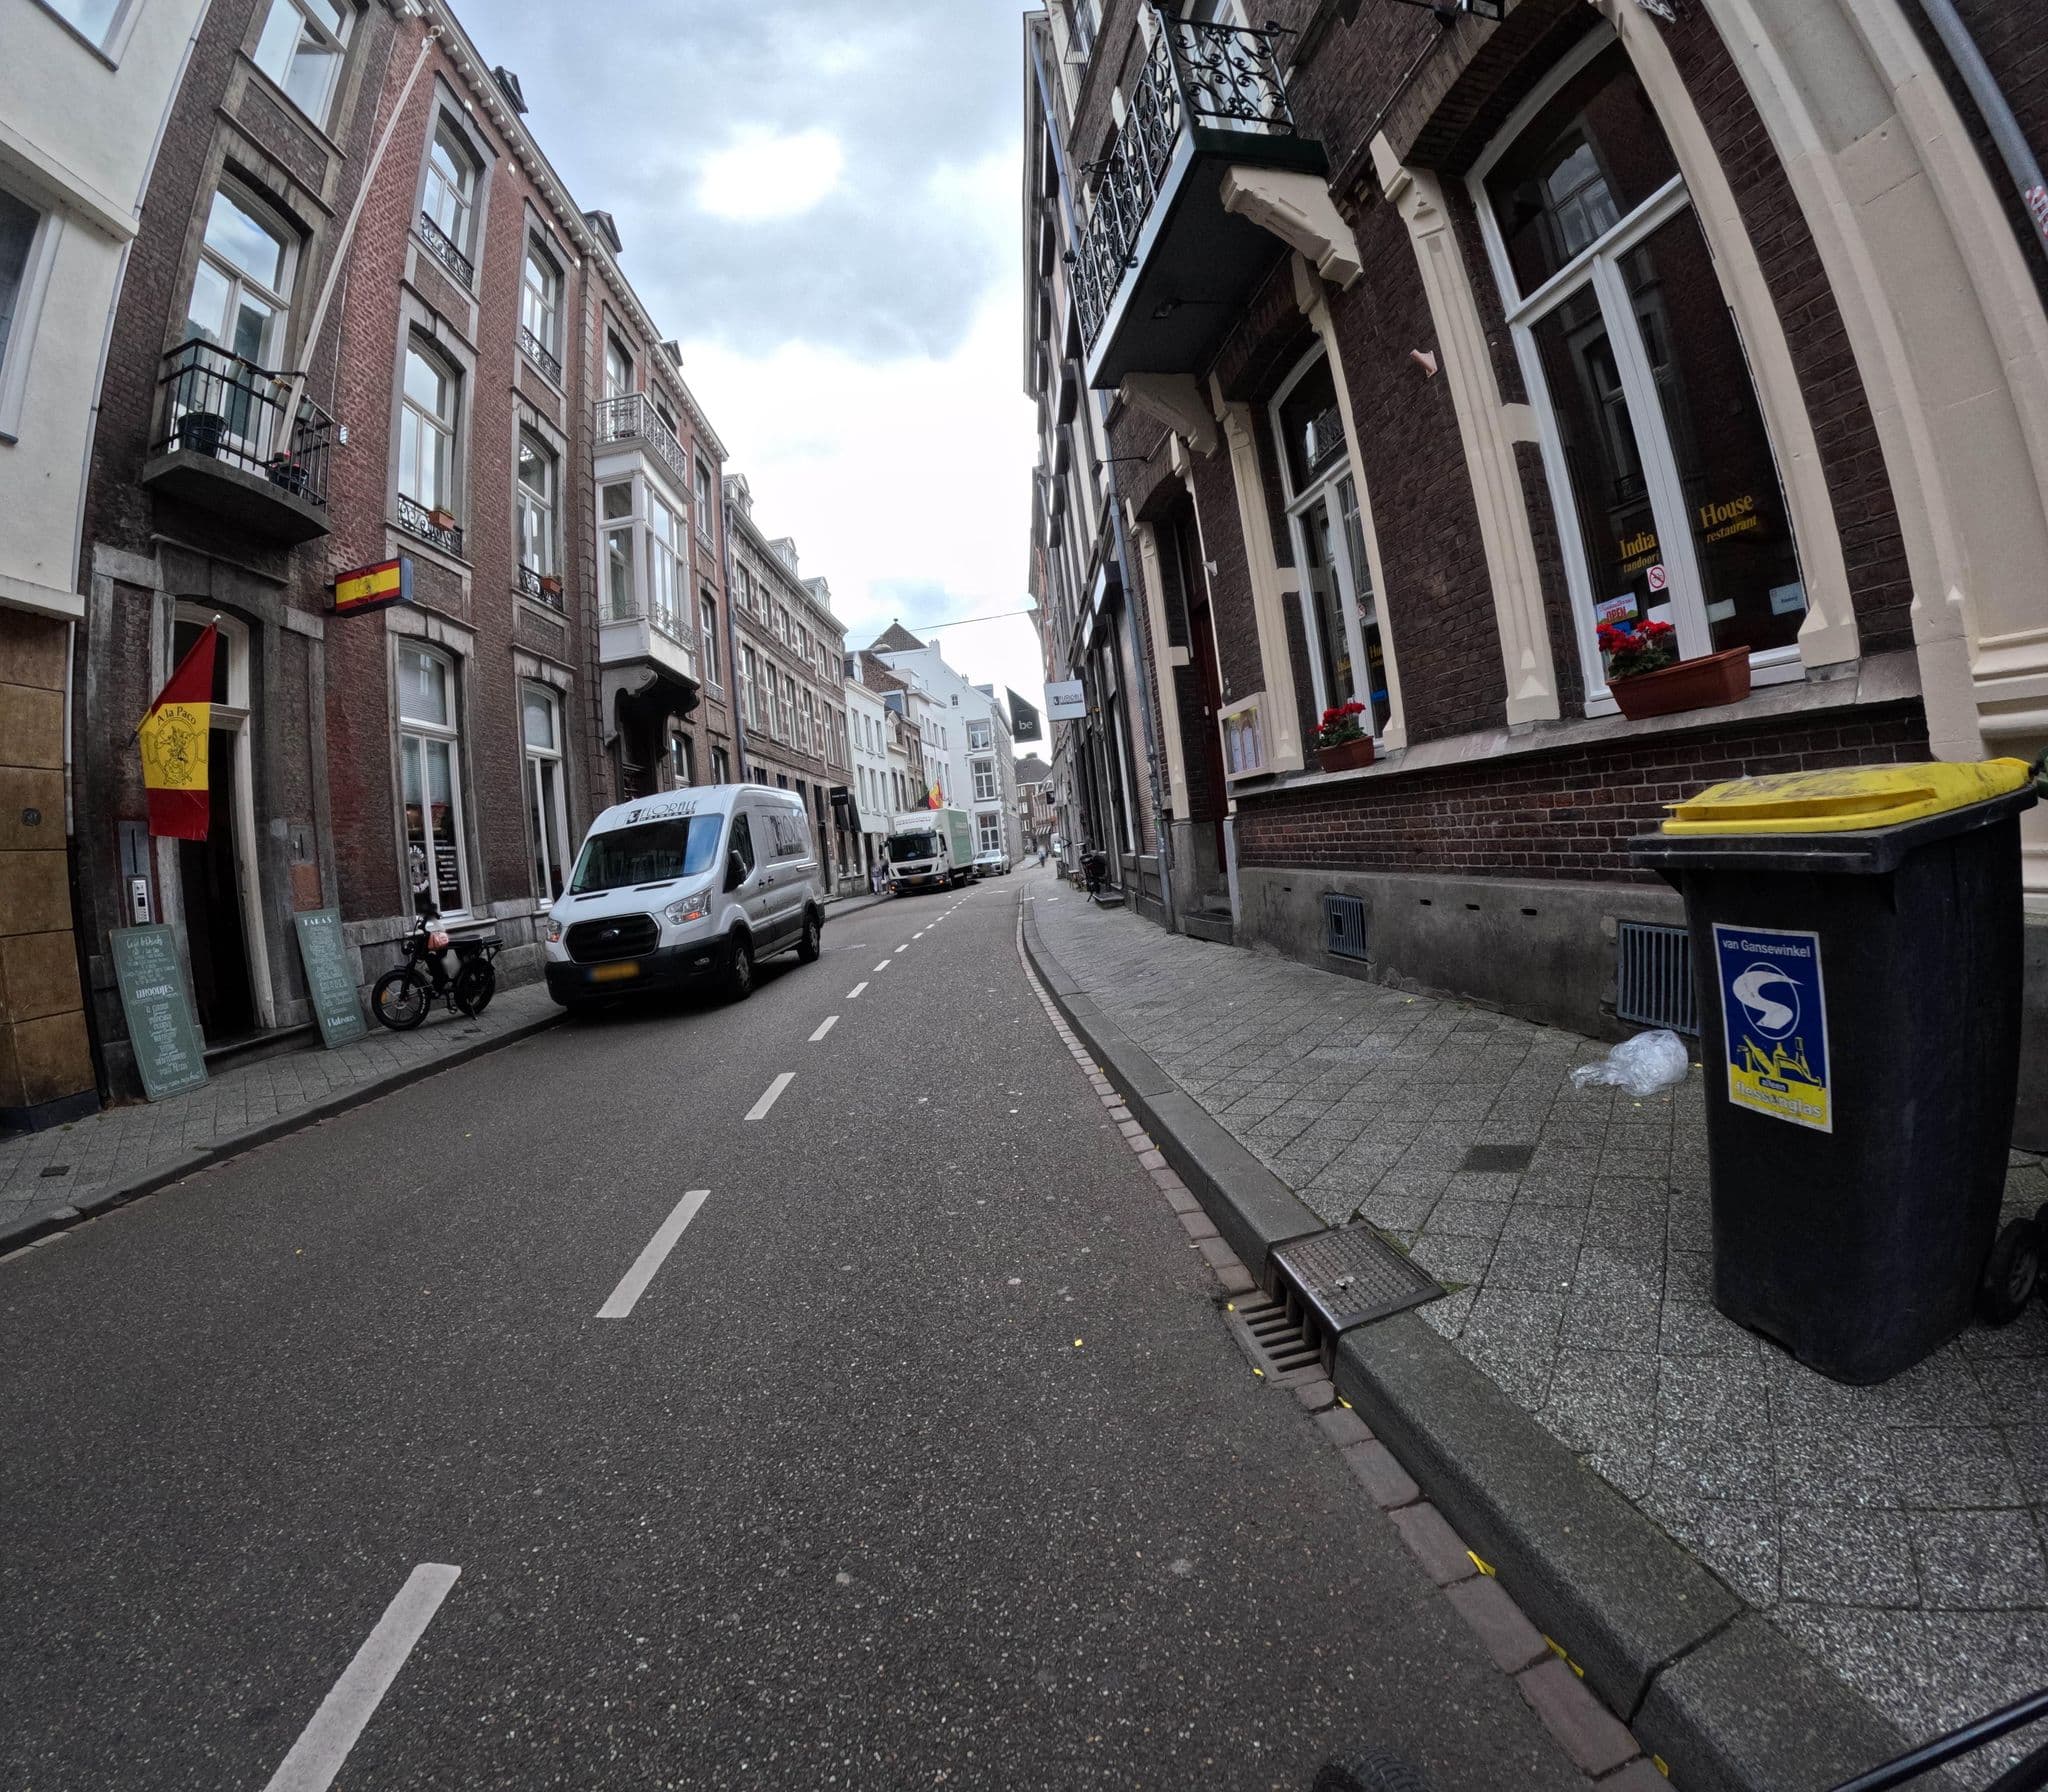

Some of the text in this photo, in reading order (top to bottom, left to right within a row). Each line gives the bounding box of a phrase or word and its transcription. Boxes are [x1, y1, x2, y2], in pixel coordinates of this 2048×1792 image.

[1699, 495, 1754, 529] House
[1706, 515, 1758, 544] restaurant
[1619, 531, 1658, 559] India
[1623, 552, 1660, 574] tandoori
[156, 706, 197, 726] A la Paco
[1018, 720, 1033, 730] be
[1723, 940, 1811, 958] van Gansewinkel
